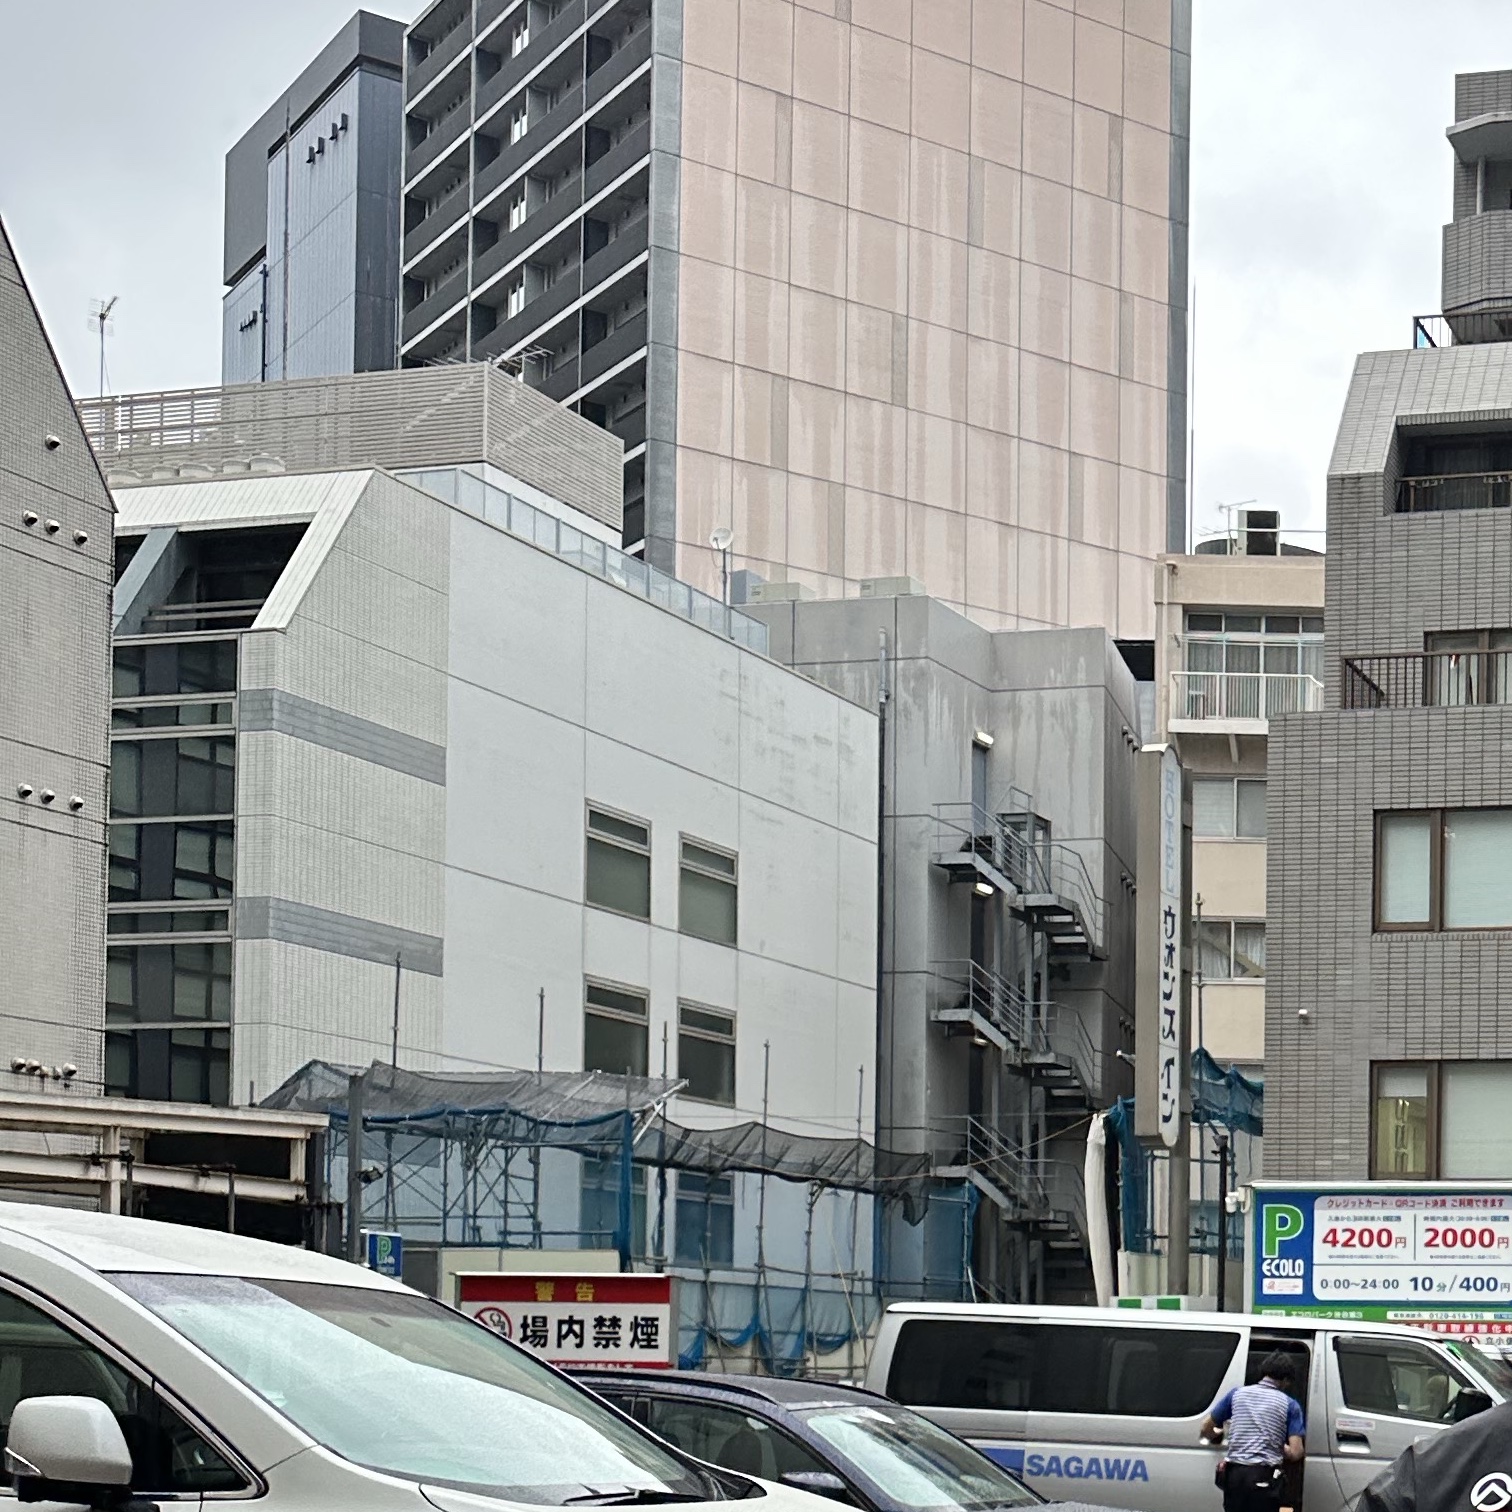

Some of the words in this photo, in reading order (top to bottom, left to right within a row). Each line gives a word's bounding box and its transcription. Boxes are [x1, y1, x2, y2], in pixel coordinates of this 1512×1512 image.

[1163, 769, 1176, 894] HOTEL
[1263, 1204, 1304, 1258] P
[1262, 1259, 1304, 1276] ECOLO
[535, 1281, 595, 1302] 警告
[519, 1314, 660, 1349] 場内禁煙
[1026, 1454, 1149, 1482] SAGAWA
